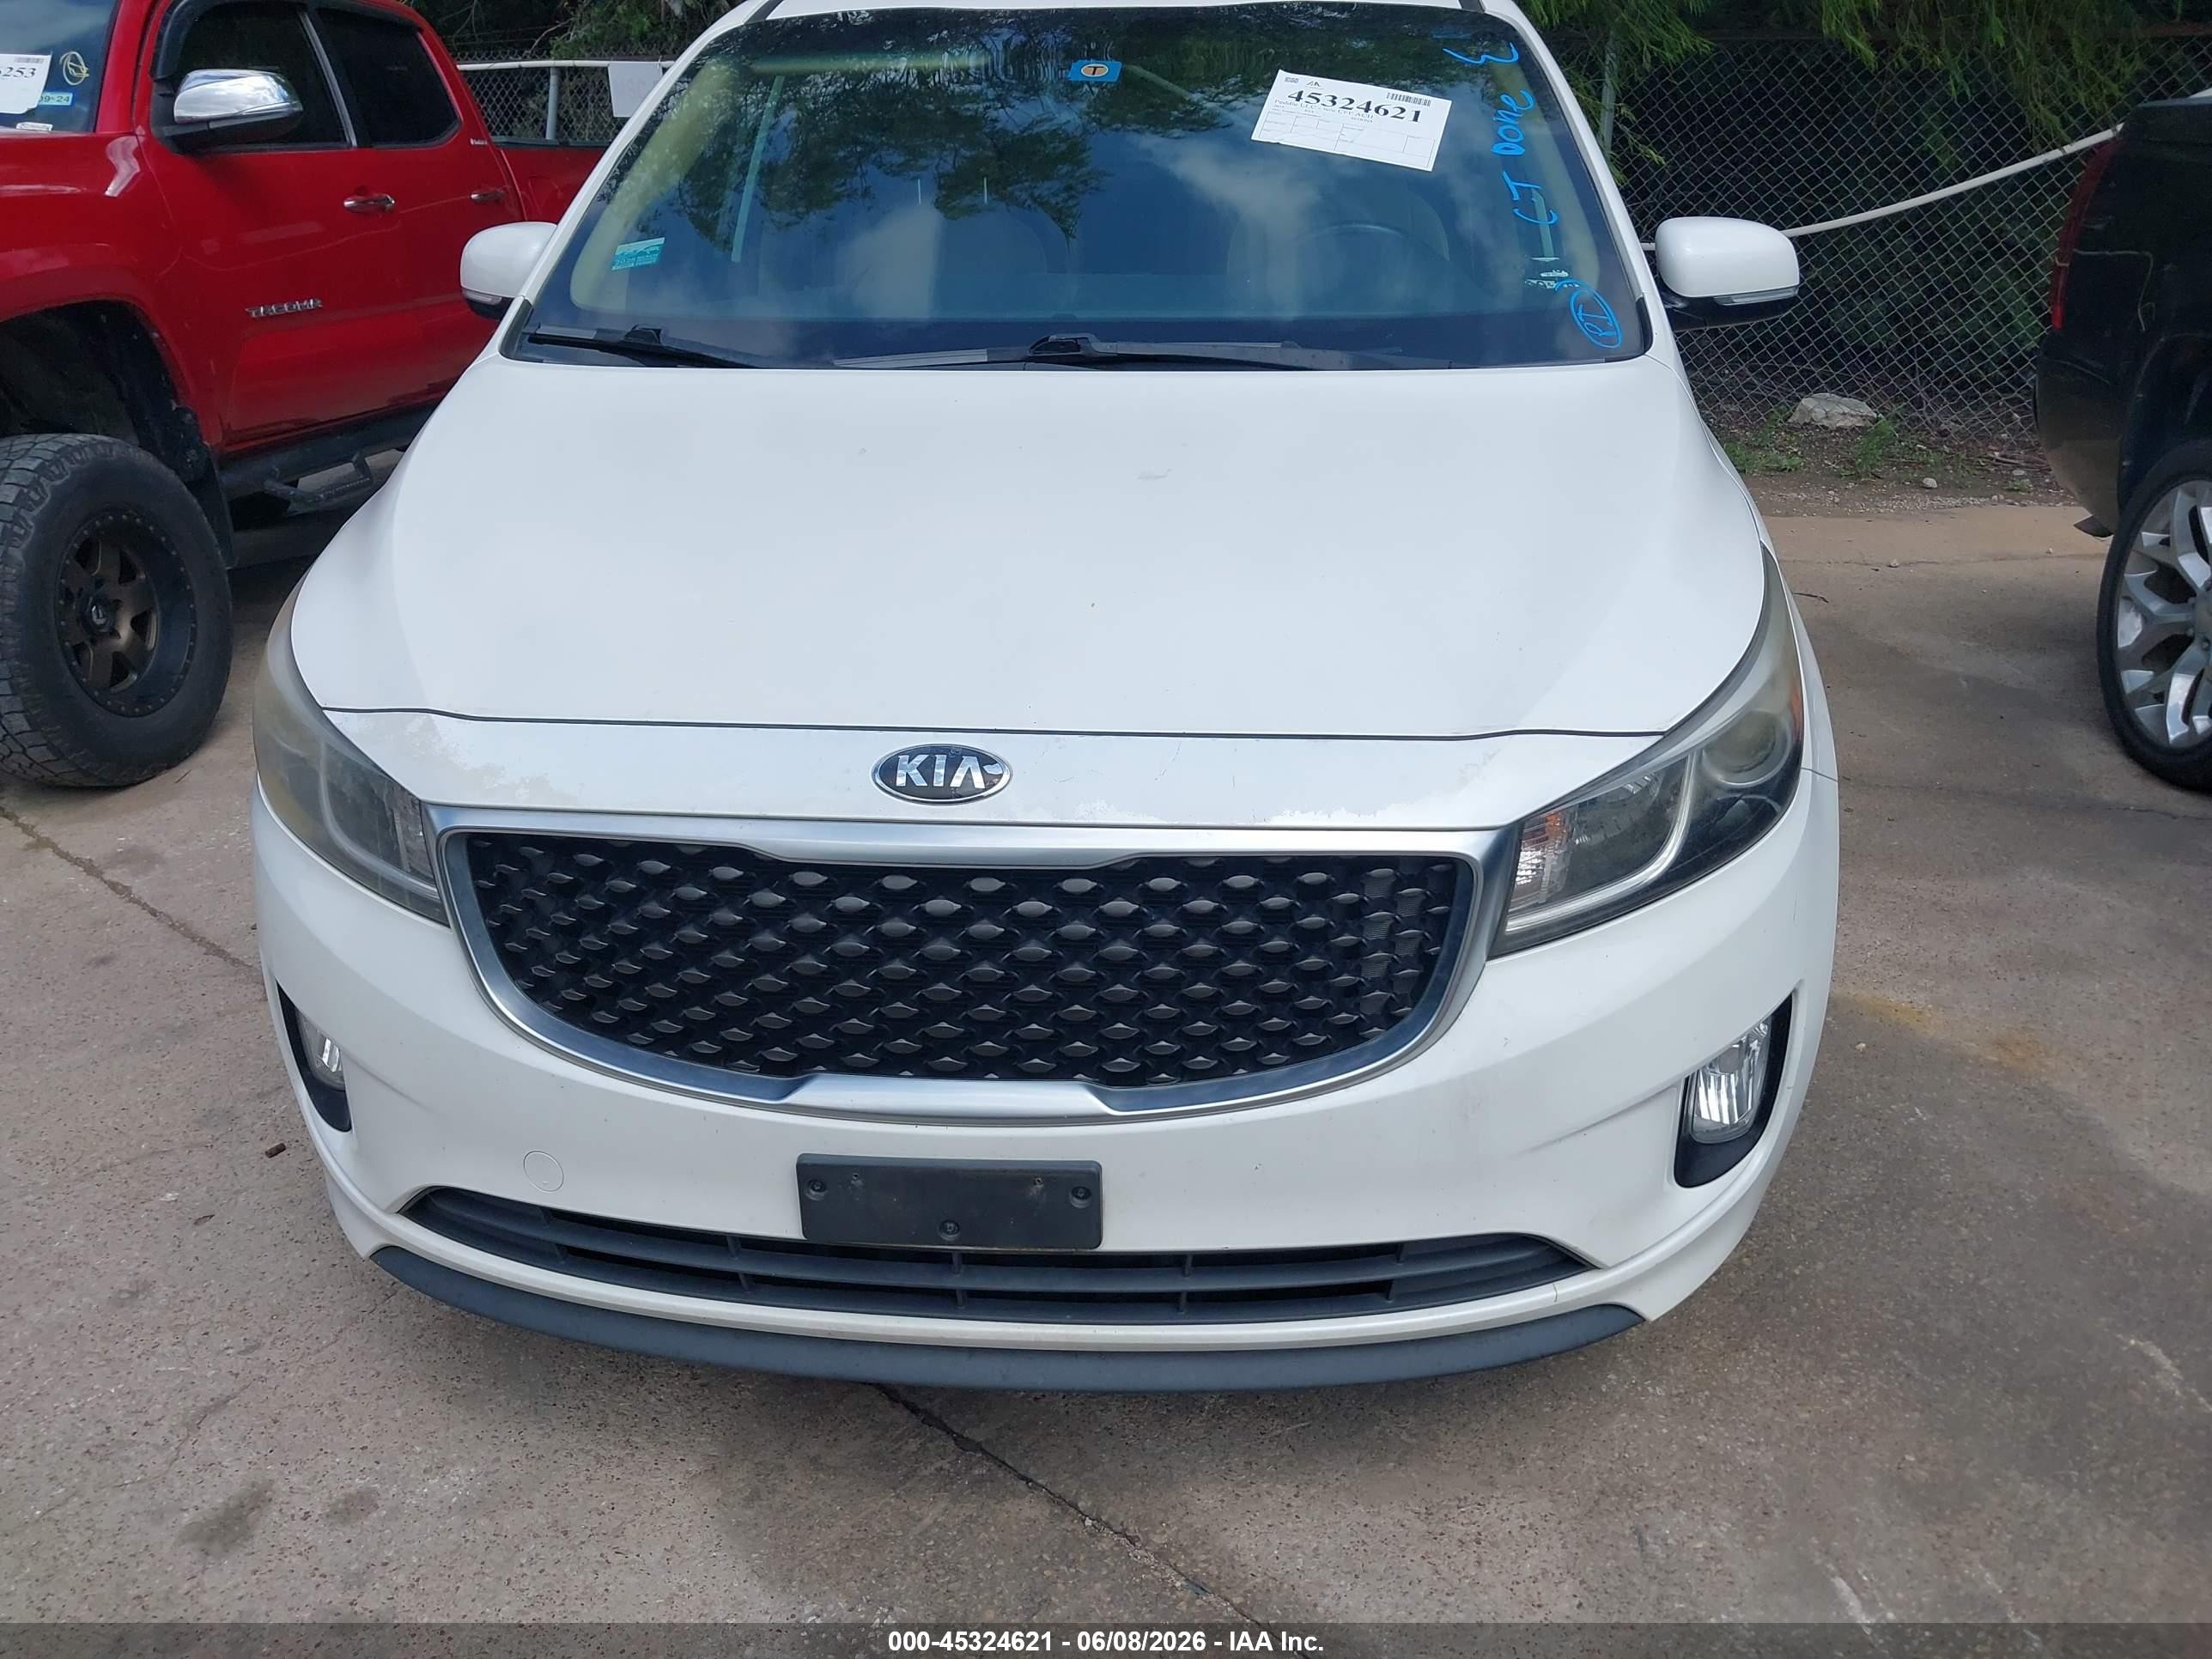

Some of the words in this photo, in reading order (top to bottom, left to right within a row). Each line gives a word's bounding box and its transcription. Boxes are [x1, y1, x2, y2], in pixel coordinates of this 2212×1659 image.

[0, 66, 36, 78] 253
[1288, 90, 1420, 123] 45324621
[245, 299, 323, 318] TACOMA
[896, 754, 986, 789] KIA
